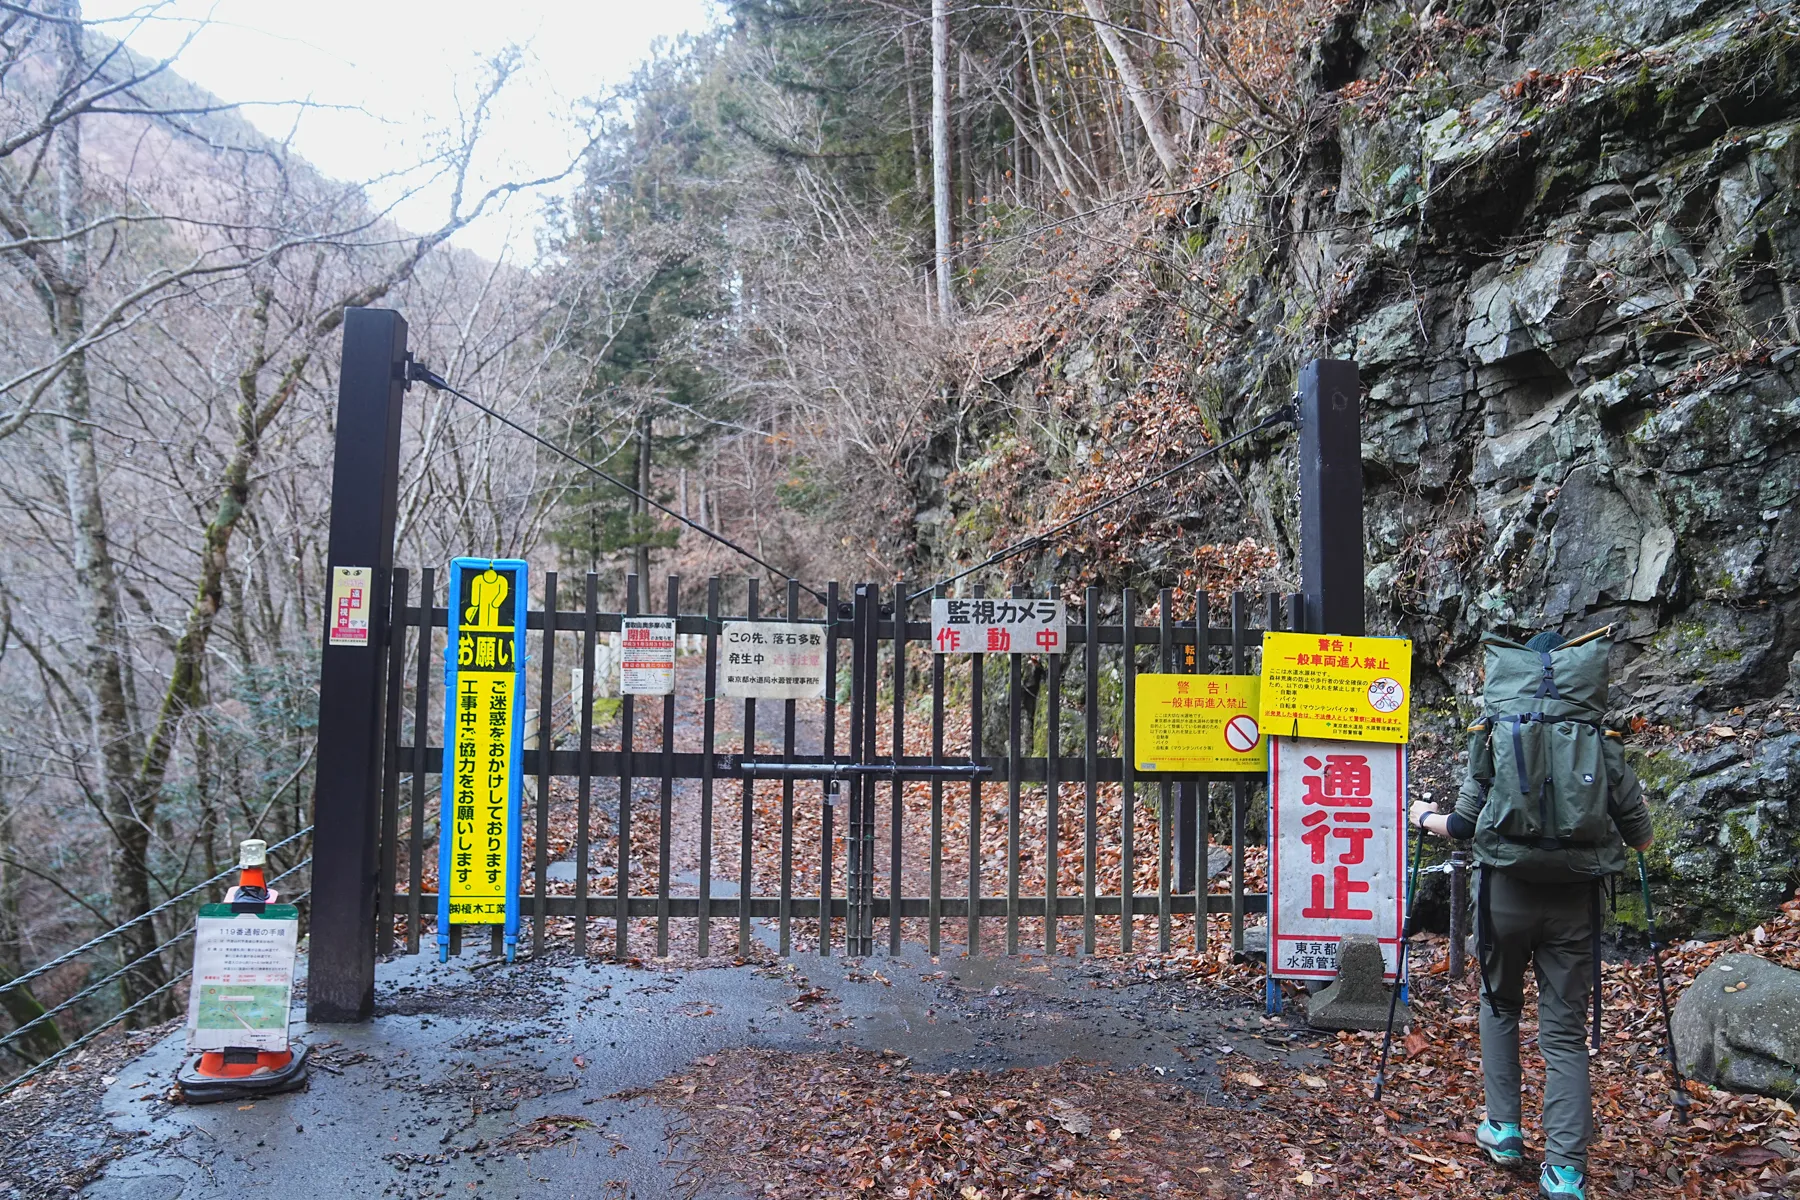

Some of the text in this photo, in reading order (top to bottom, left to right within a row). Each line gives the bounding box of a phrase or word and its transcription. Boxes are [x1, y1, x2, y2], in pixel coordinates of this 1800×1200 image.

[947, 600, 1057, 625] 監視カメラ
[627, 629, 650, 641] 閉鎖
[729, 632, 821, 646] この先、落石多数
[936, 627, 1058, 652] 作動中
[1317, 638, 1353, 652] 警告！
[457, 636, 516, 669] お願い
[728, 652, 765, 665] 発生中
[1283, 652, 1390, 671] 一般車両進入禁止
[727, 675, 820, 685] 東京都水道局水源管理事務所
[1269, 668, 1332, 678] ここは水道水源林です。
[1177, 680, 1229, 695] 警告！
[1268, 682, 1366, 693] ため、以下の乗り入れを禁止します。
[1269, 675, 1369, 687] 森林荒廃の防止や歩行者の安全確保の
[1161, 697, 1248, 709] 一般車両進入禁止
[1332, 722, 1364, 731] 東京都水道局
[456, 679, 479, 891] 工事中ご協力をお願いします。
[485, 679, 507, 892] ご迷惑をおかけしております。
[1300, 754, 1374, 921] 通行止
[219, 927, 285, 937] 119番通報の手順
